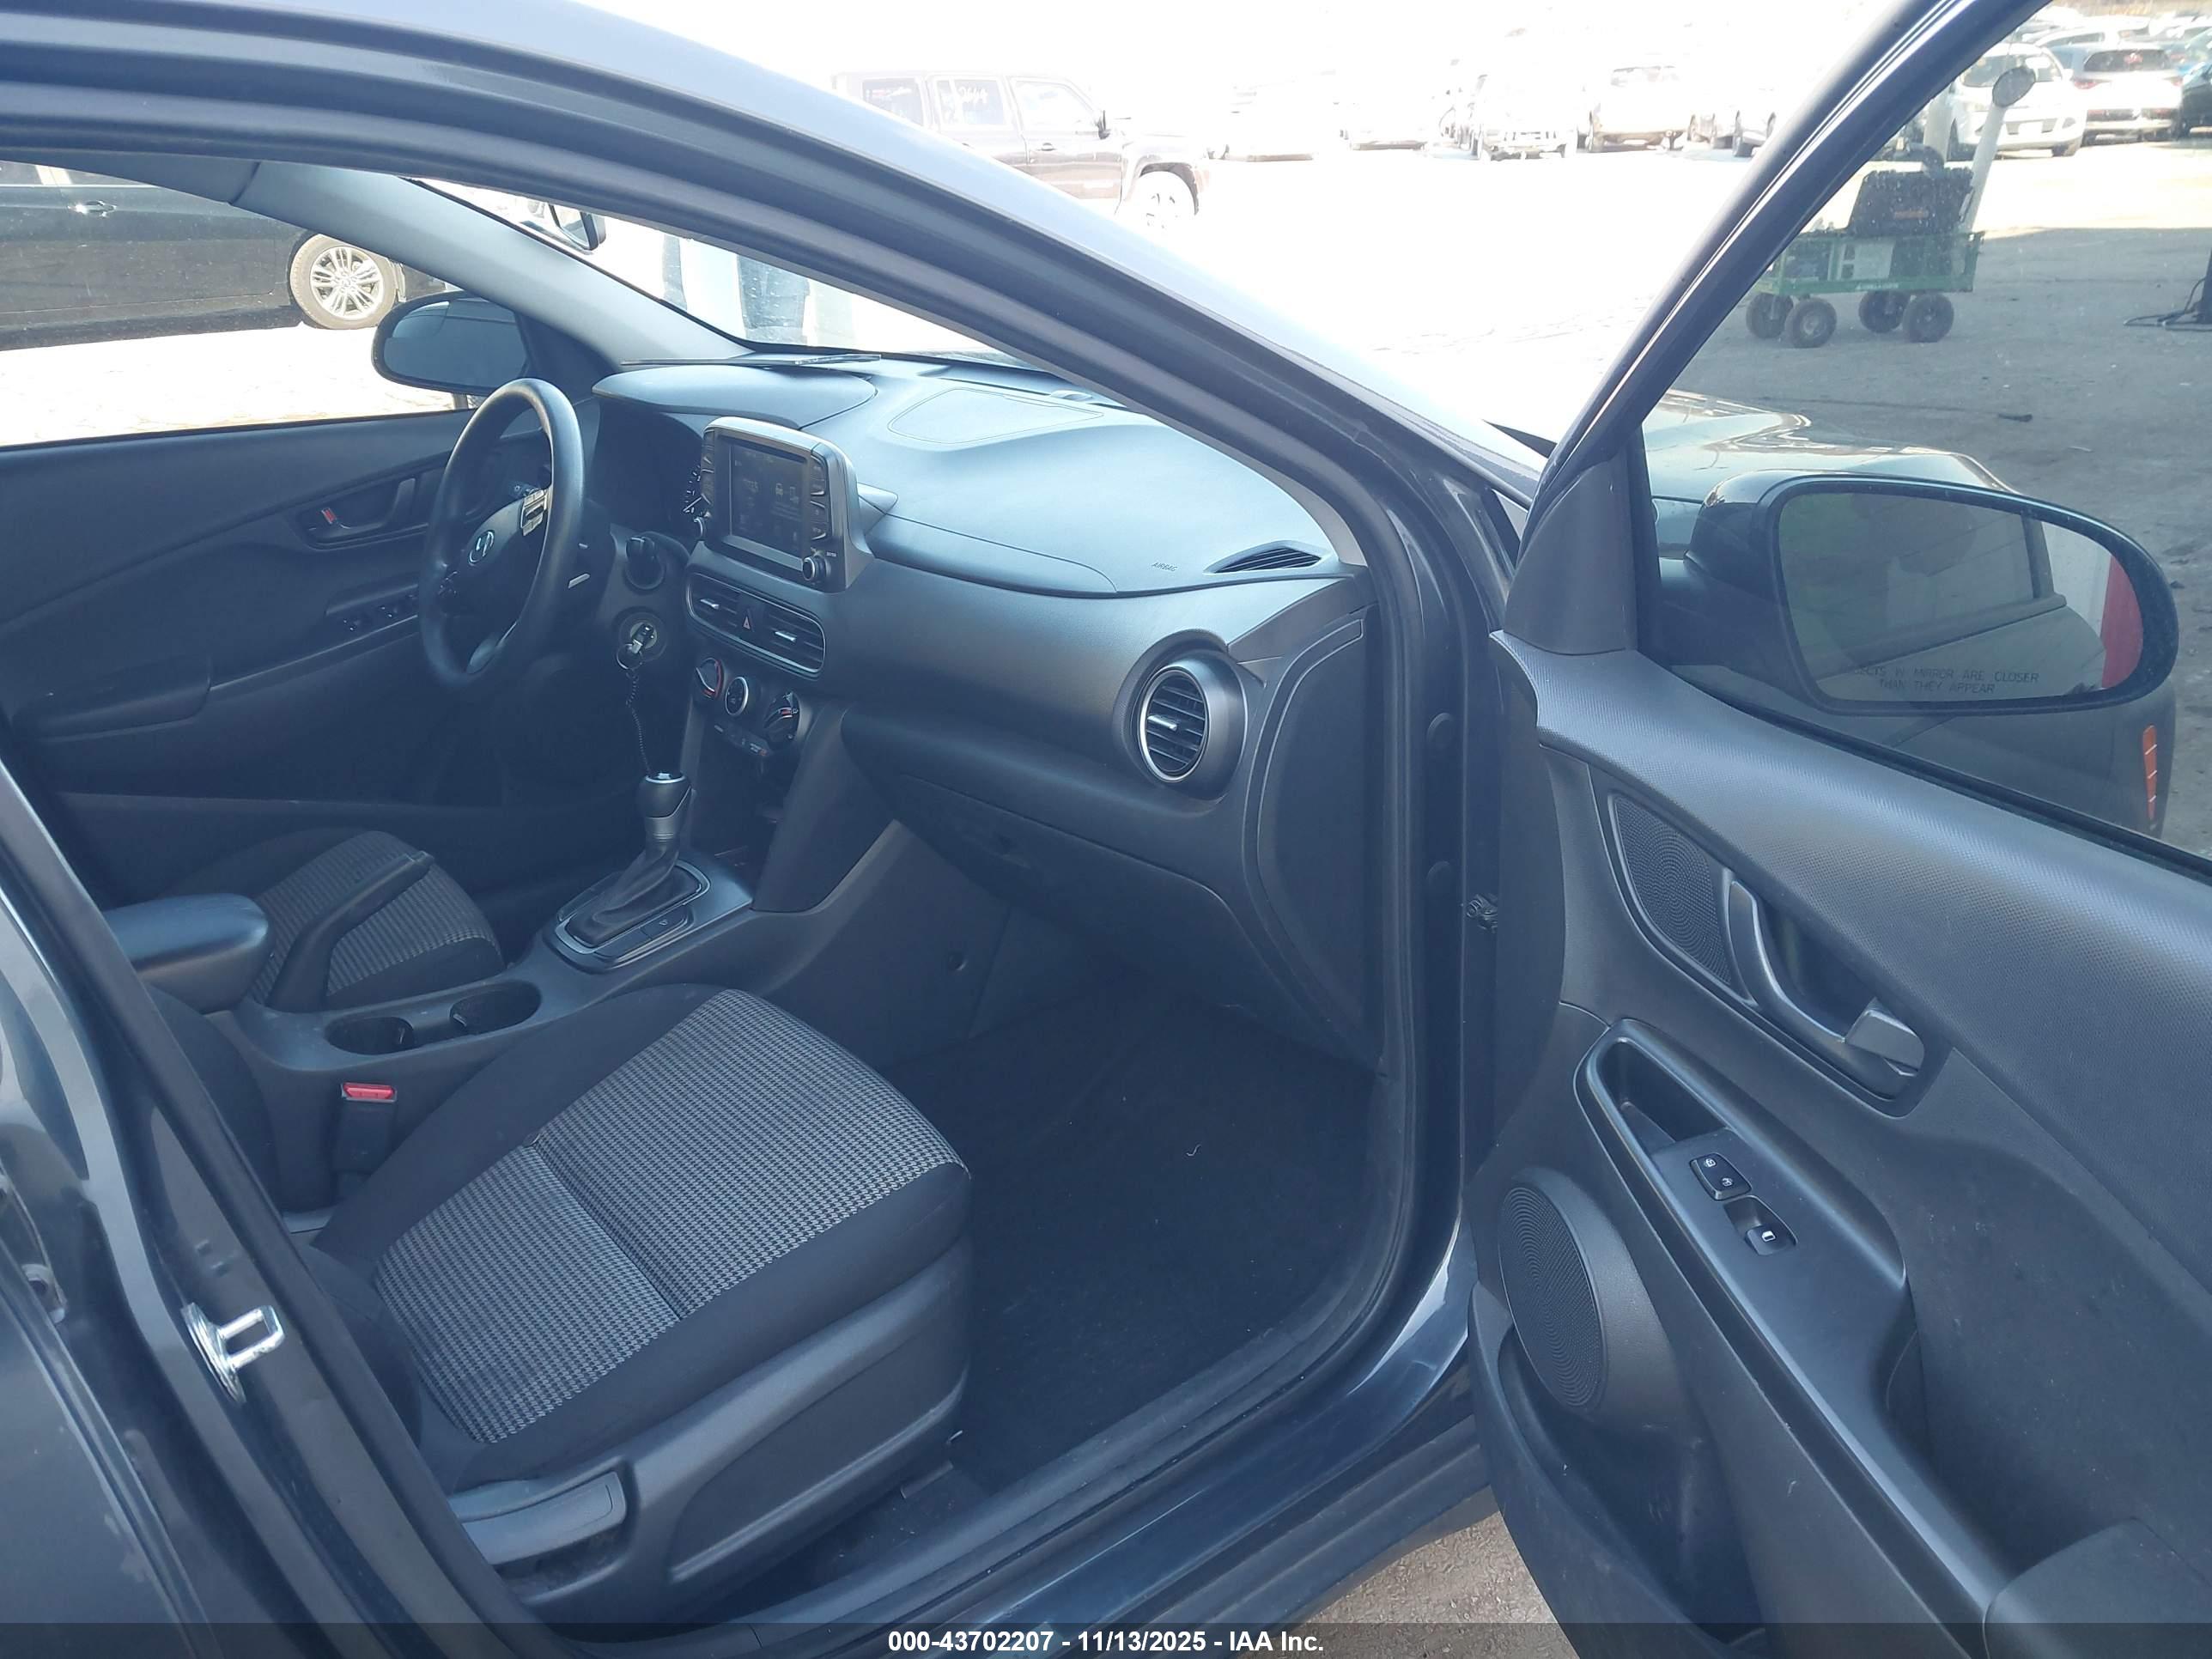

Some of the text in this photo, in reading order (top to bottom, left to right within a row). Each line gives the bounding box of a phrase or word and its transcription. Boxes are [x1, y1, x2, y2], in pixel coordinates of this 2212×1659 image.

[1151, 562, 1178, 573] AIRBAG
[1914, 669, 1954, 679] MIRROR
[1962, 670, 1985, 681] ARE
[1995, 672, 2040, 684] CLOSER
[1880, 678, 1996, 694] THAN THEY APPEAR
